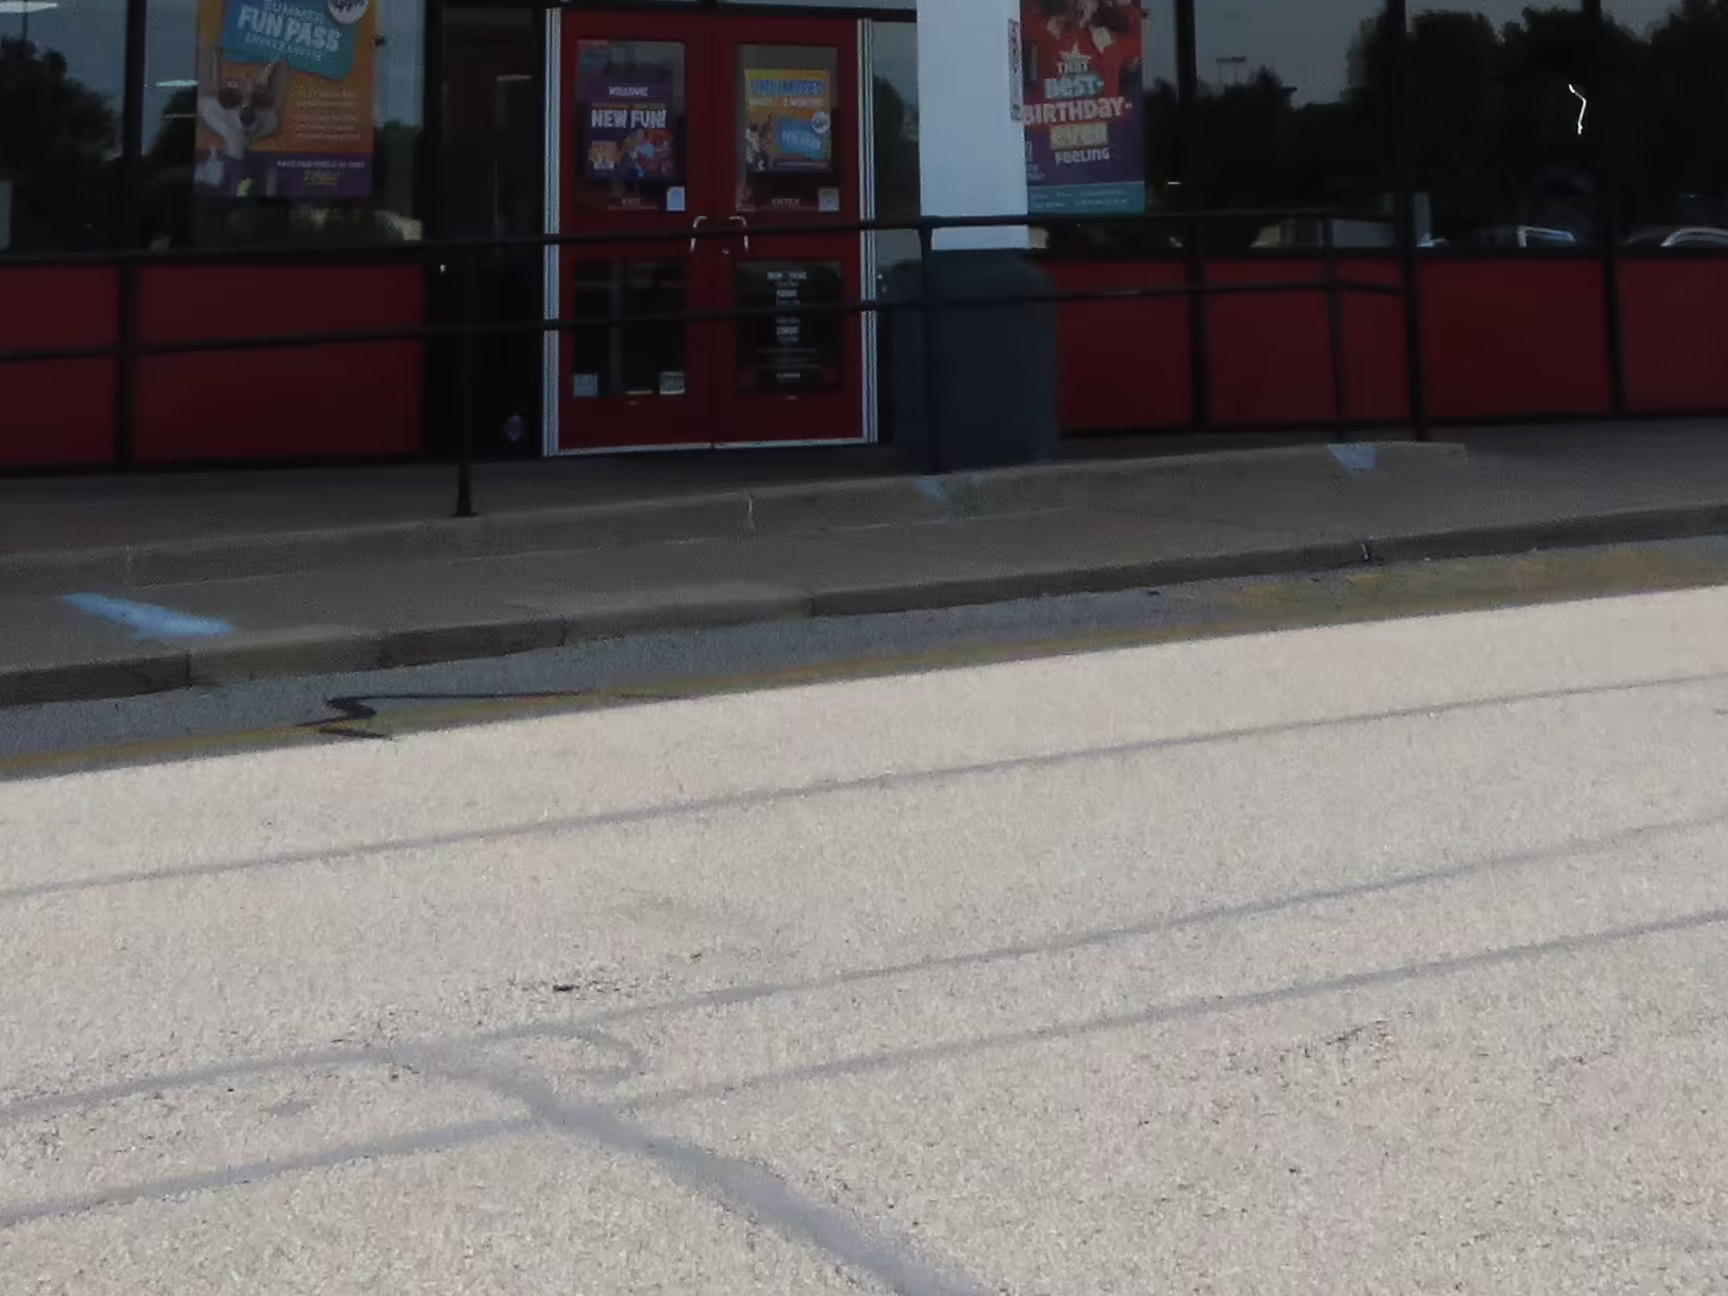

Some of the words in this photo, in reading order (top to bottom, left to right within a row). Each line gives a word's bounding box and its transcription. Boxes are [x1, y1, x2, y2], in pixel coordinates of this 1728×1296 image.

[238, 3, 283, 38] FUN
[283, 16, 340, 53] PASS
[591, 109, 627, 129] NEW
